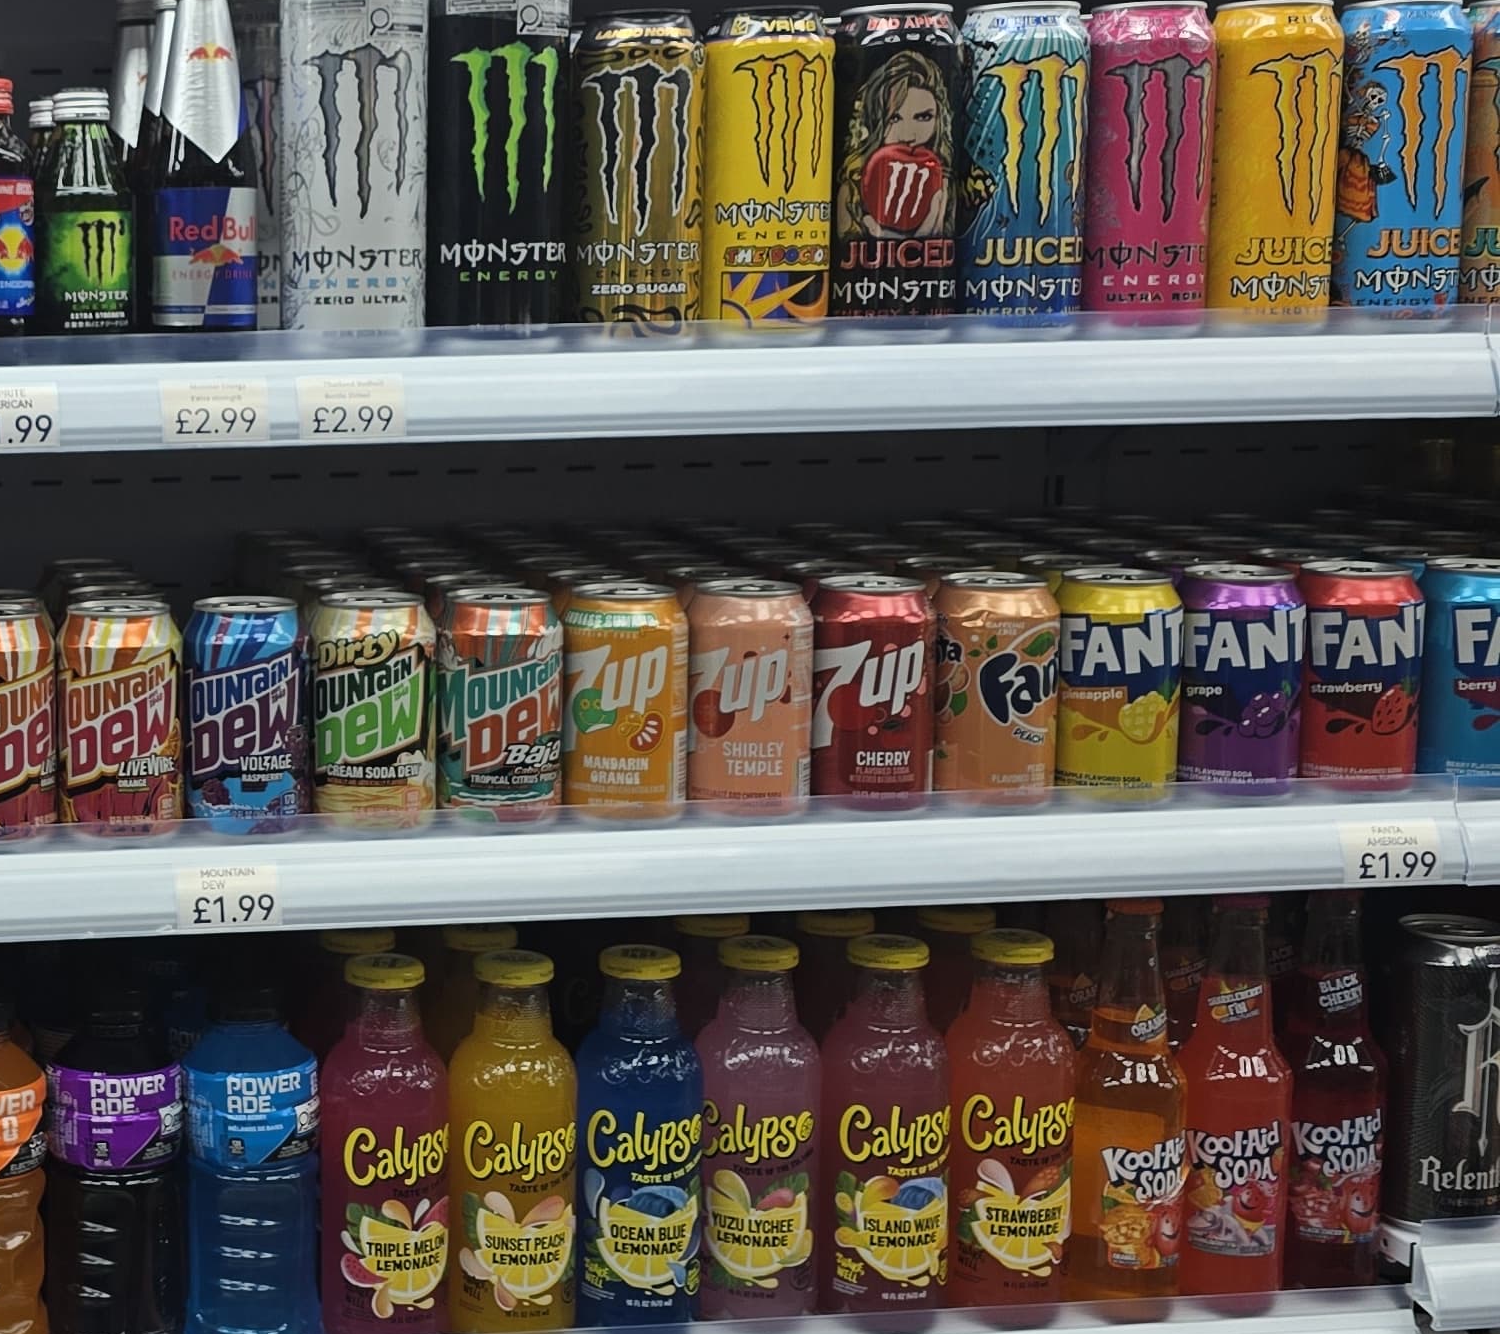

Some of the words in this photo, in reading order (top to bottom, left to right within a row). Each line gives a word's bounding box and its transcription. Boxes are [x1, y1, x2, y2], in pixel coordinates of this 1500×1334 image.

[441, 240, 567, 266] MONSTER
[841, 238, 955, 269] JUICED
[591, 282, 630, 295] ZERO
[633, 282, 686, 294] SUGAR
[314, 294, 354, 306] ZERO
[363, 293, 408, 305] ULTRA
[175, 406, 257, 436] £2.99
[312, 404, 394, 434] £2.99
[319, 630, 398, 667] Dirty
[1186, 684, 1223, 699] grape
[1310, 680, 1383, 696] strawberry
[1457, 679, 1497, 692] berry
[813, 640, 925, 750] 7up
[1061, 688, 1125, 703] pineapple
[723, 741, 785, 758] SHIRLEY
[240, 754, 292, 772] VOLTAGE
[583, 755, 649, 770] MANDARIN
[726, 759, 783, 776] TEMPLE
[856, 751, 911, 767] CHERRY
[118, 778, 148, 788] ORANGE
[241, 772, 284, 783] RASPBERRY
[1366, 836, 1418, 847] AMERICAN
[200, 867, 255, 879] MOUNTAIN
[1360, 851, 1437, 880] £1.99
[202, 879, 225, 890] DEW
[193, 894, 275, 925] £1.99
[1319, 971, 1359, 994] BLACK
[1319, 988, 1363, 1009] CHERRY
[90, 1074, 166, 1099] POWER
[226, 1072, 301, 1097] POWER
[1292, 1109, 1382, 1155] Kool-Aid
[464, 1120, 577, 1182] Calypso
[1323, 1142, 1378, 1177] SODA
[1216, 1154, 1278, 1189] SODA
[712, 1213, 746, 1233] YUZU
[748, 1218, 794, 1235] LYCHEE
[986, 1205, 1063, 1225] STRAWBERRY
[610, 1227, 656, 1241] OCEAN
[658, 1223, 687, 1240] BLUE
[864, 1217, 912, 1235] ISLAND
[914, 1215, 942, 1232] WAVE
[990, 1222, 1060, 1238] LEMONADE
[367, 1241, 411, 1258] TRIPLE
[413, 1234, 447, 1256] MELON
[485, 1234, 532, 1251] SUNSET
[533, 1233, 566, 1251] PEACH
[717, 1230, 789, 1248] LEMONADE
[869, 1232, 938, 1249] LEMONADE
[614, 1241, 684, 1256] LEMONADE
[376, 1254, 442, 1273] LEMONADE
[491, 1249, 561, 1268] LEMONADE
